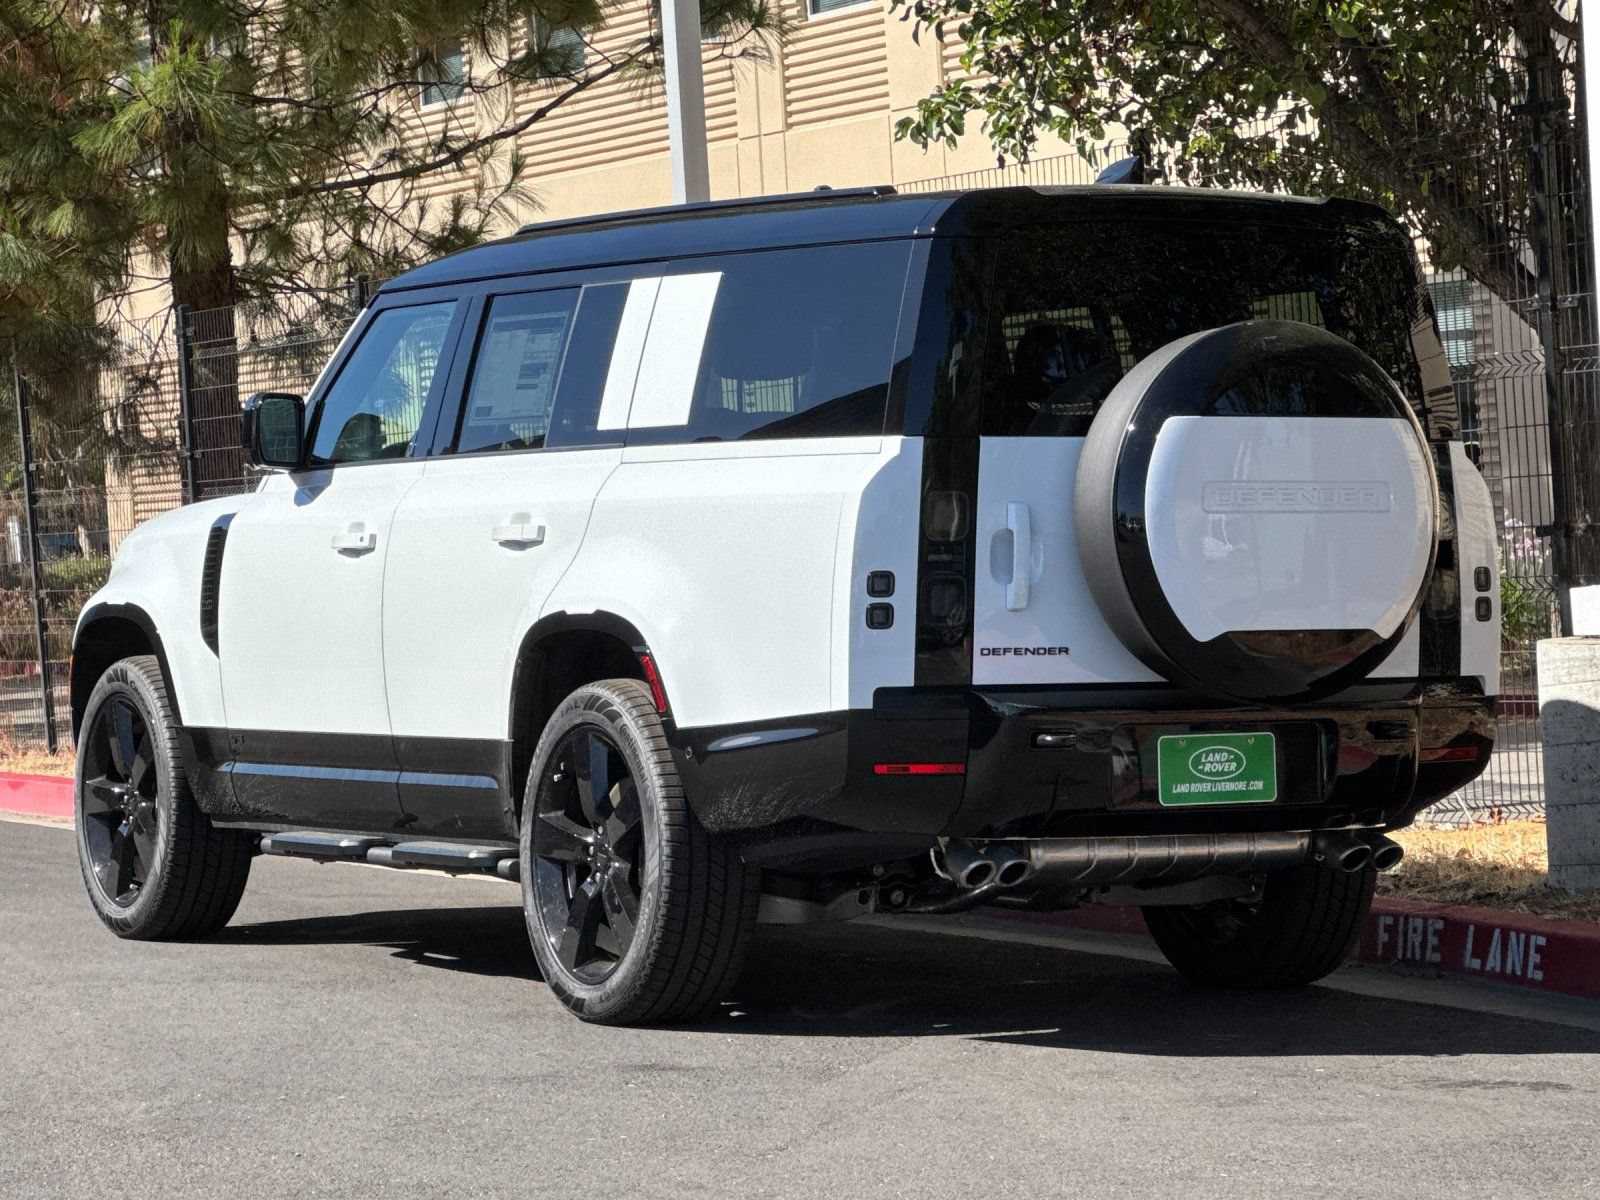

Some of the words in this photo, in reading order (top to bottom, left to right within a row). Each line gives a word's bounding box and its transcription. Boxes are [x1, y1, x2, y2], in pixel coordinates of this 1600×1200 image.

[1214, 487, 1380, 507] DEFENDER
[980, 647, 1070, 657] DEFENDER
[619, 722, 648, 785] Continental
[1201, 752, 1228, 762] LAND
[1204, 762, 1237, 772] ROVER
[1172, 784, 1190, 793] LAND
[1190, 783, 1212, 793] ROVER
[1377, 915, 1445, 962] FIRE
[1464, 924, 1547, 981] LANE
